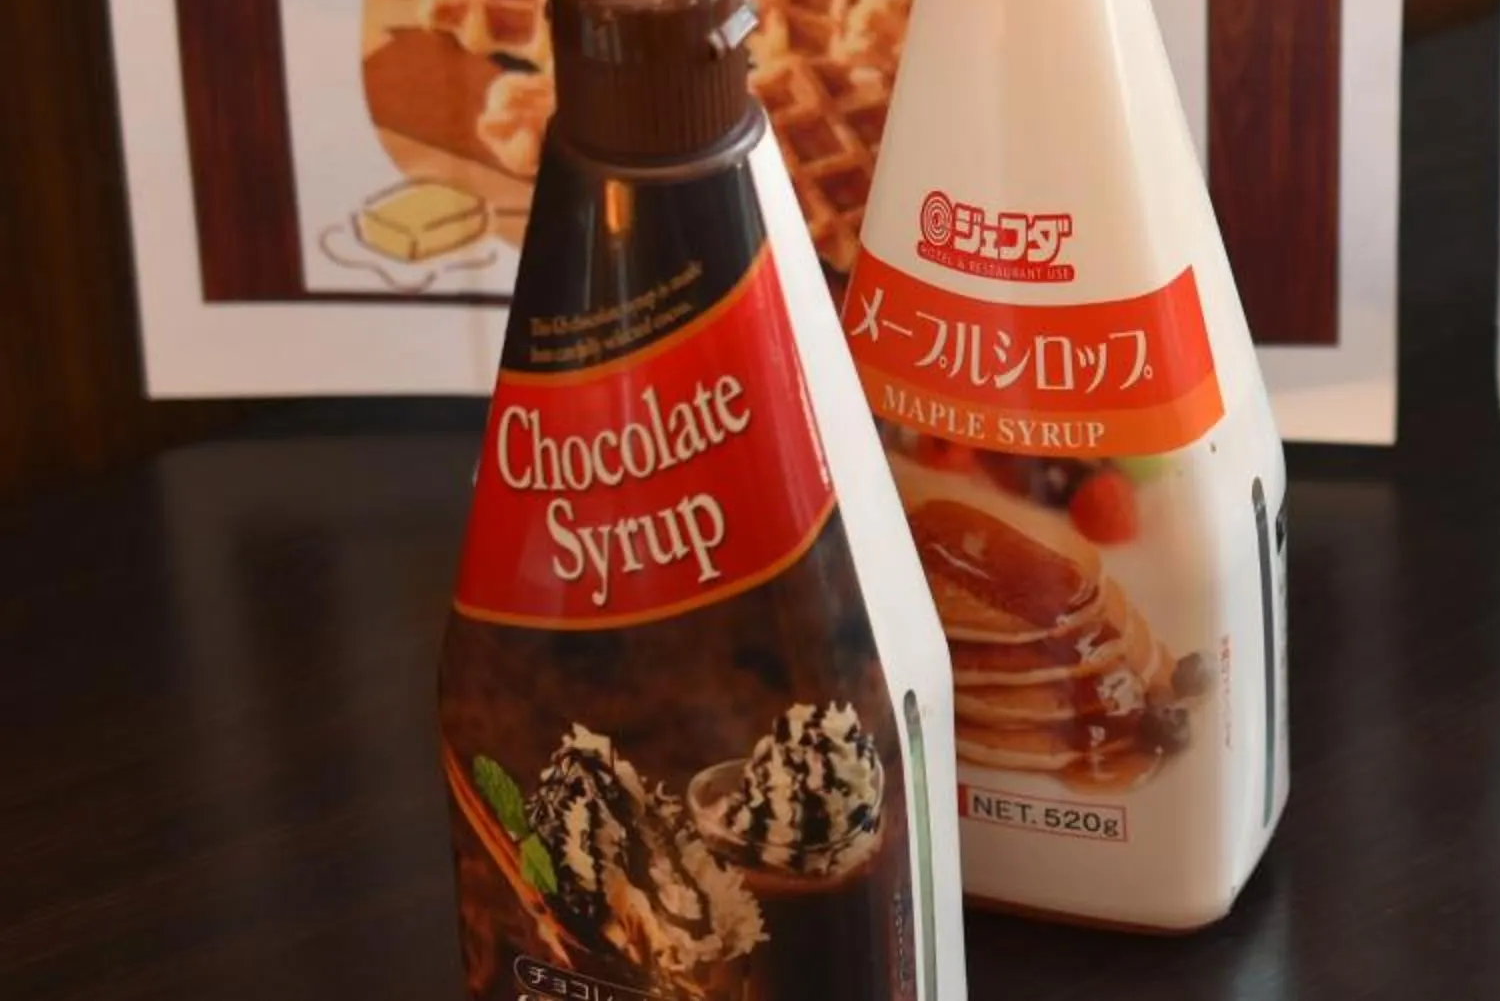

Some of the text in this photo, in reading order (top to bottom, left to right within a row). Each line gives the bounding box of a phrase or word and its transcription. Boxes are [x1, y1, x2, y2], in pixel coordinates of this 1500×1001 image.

[969, 261, 1042, 280] RESTAURANT
[1047, 268, 1070, 281] USE
[850, 286, 1154, 394] メープルシロップ
[496, 374, 752, 491] Chocolate
[882, 384, 1106, 448] MAPLE SYRUP
[546, 492, 726, 607] Syrup
[1044, 807, 1120, 838] 520g
